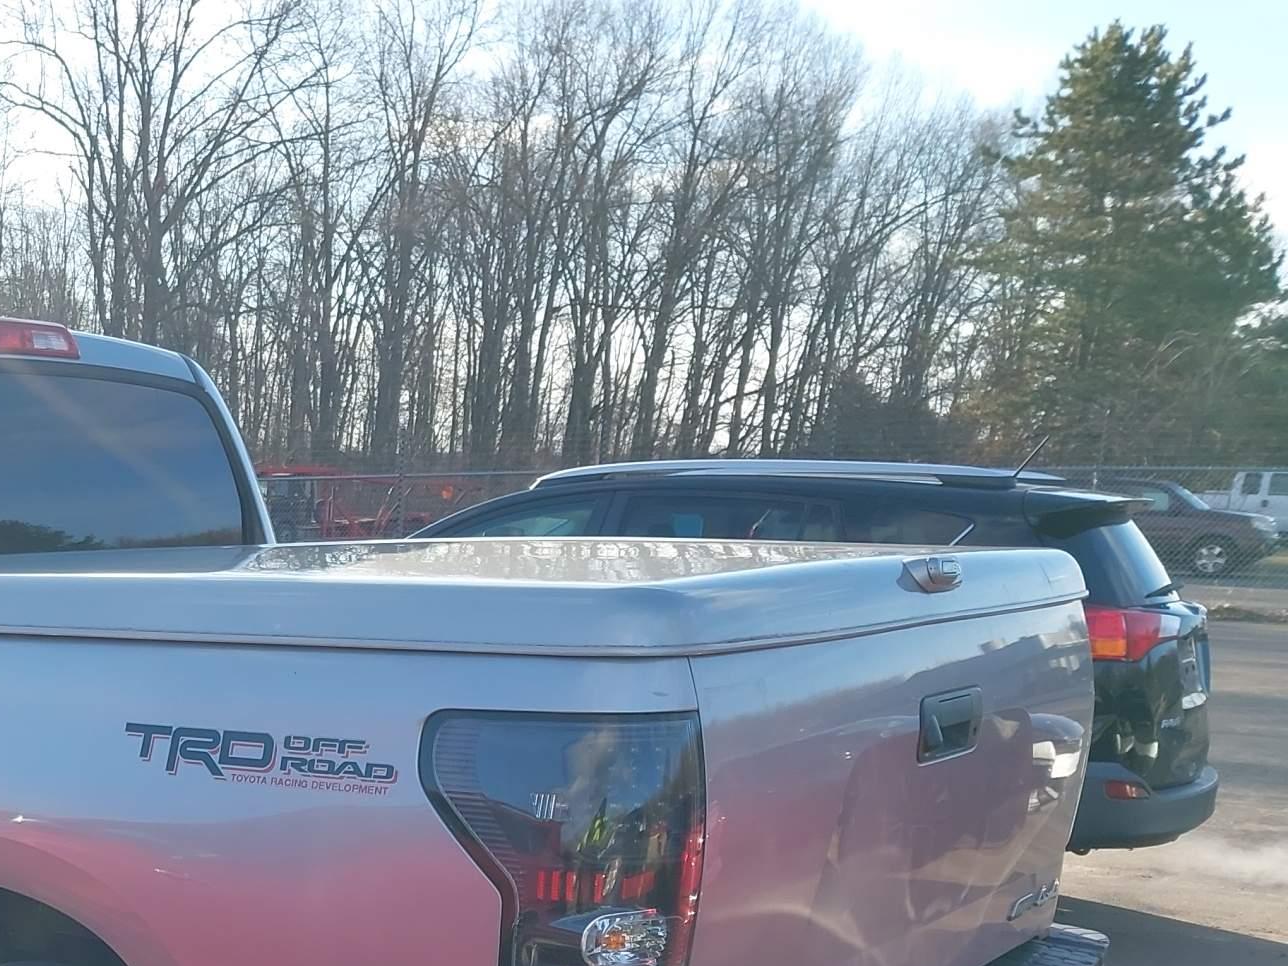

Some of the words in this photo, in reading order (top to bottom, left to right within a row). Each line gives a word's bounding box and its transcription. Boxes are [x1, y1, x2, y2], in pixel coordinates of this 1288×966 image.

[124, 721, 278, 781] TRD
[283, 735, 370, 759] OFF
[280, 756, 398, 785] ROAD
[231, 773, 267, 786] TOYOTA
[270, 777, 309, 790] RACING
[311, 780, 389, 796] DEVELOPMENT
